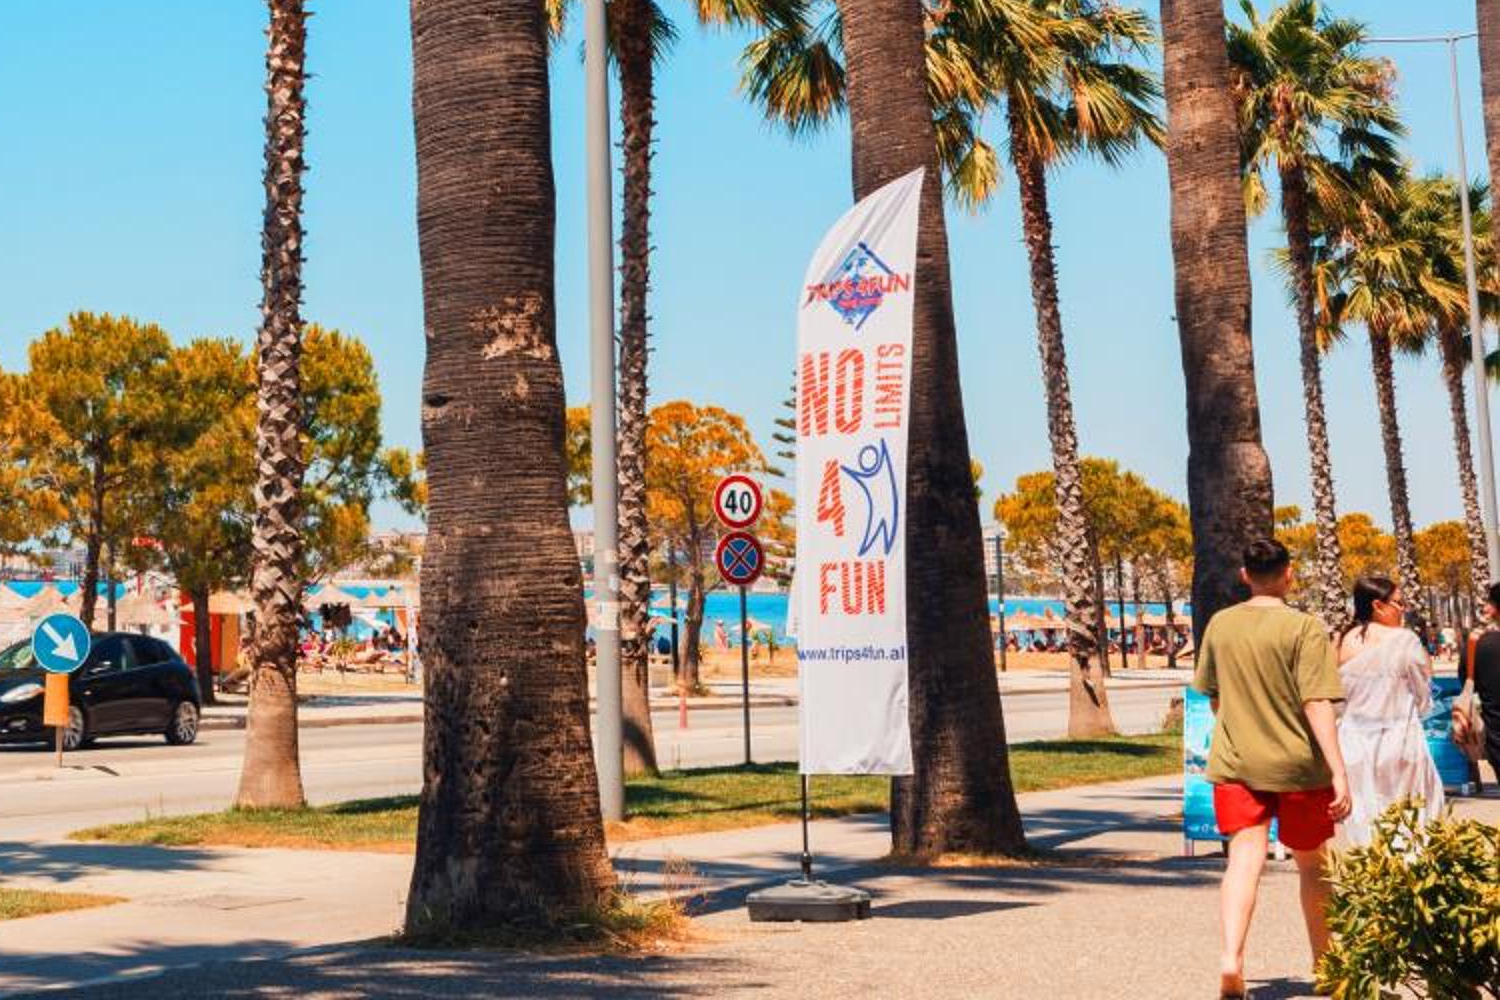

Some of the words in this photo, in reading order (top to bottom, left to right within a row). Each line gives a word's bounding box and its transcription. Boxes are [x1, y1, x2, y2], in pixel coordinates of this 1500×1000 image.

[801, 348, 864, 437] NO
[874, 343, 905, 429] LIMITS
[724, 489, 752, 515] 40
[817, 458, 845, 537] 4
[819, 560, 885, 616] FUN
